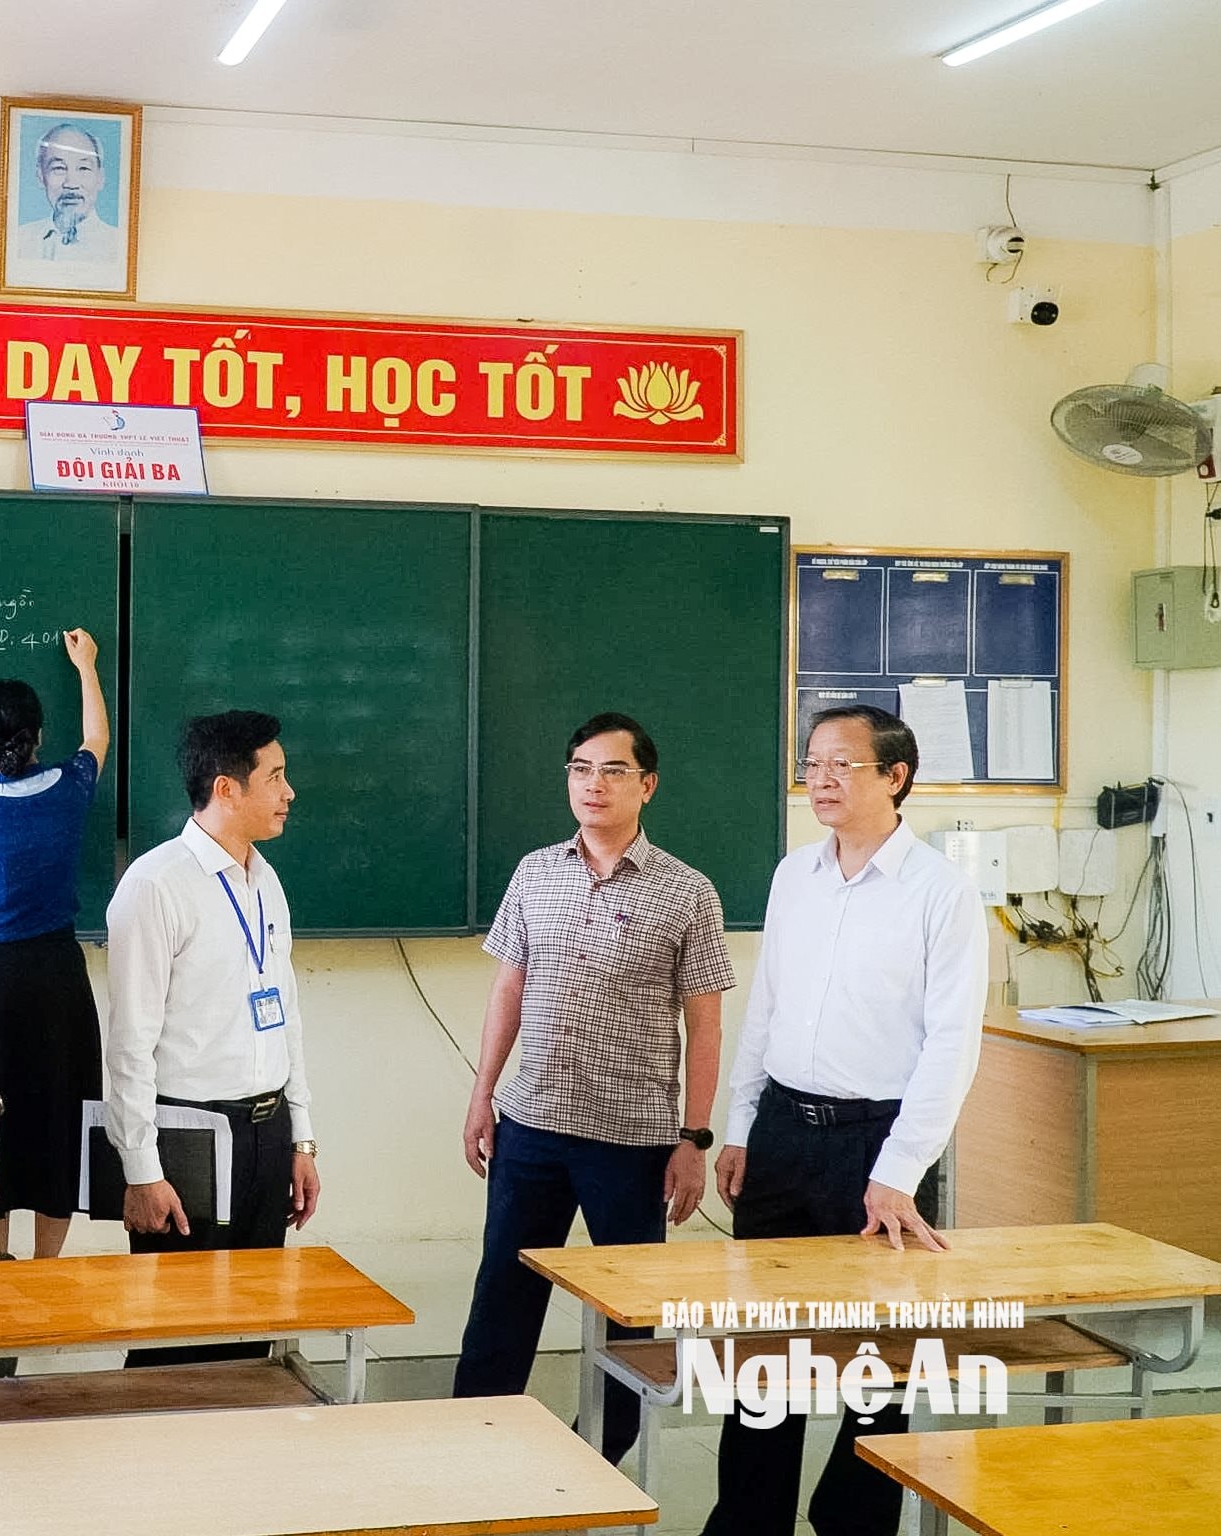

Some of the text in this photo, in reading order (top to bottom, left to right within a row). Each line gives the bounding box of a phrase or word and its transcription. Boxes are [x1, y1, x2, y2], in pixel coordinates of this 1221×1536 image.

[163, 329, 303, 419] TỐT,
[326, 354, 457, 428] HỌC
[478, 344, 592, 422] TỐT
[89, 447, 114, 457] Vinh
[56, 457, 182, 482] ĐỘI GIẢI BA
